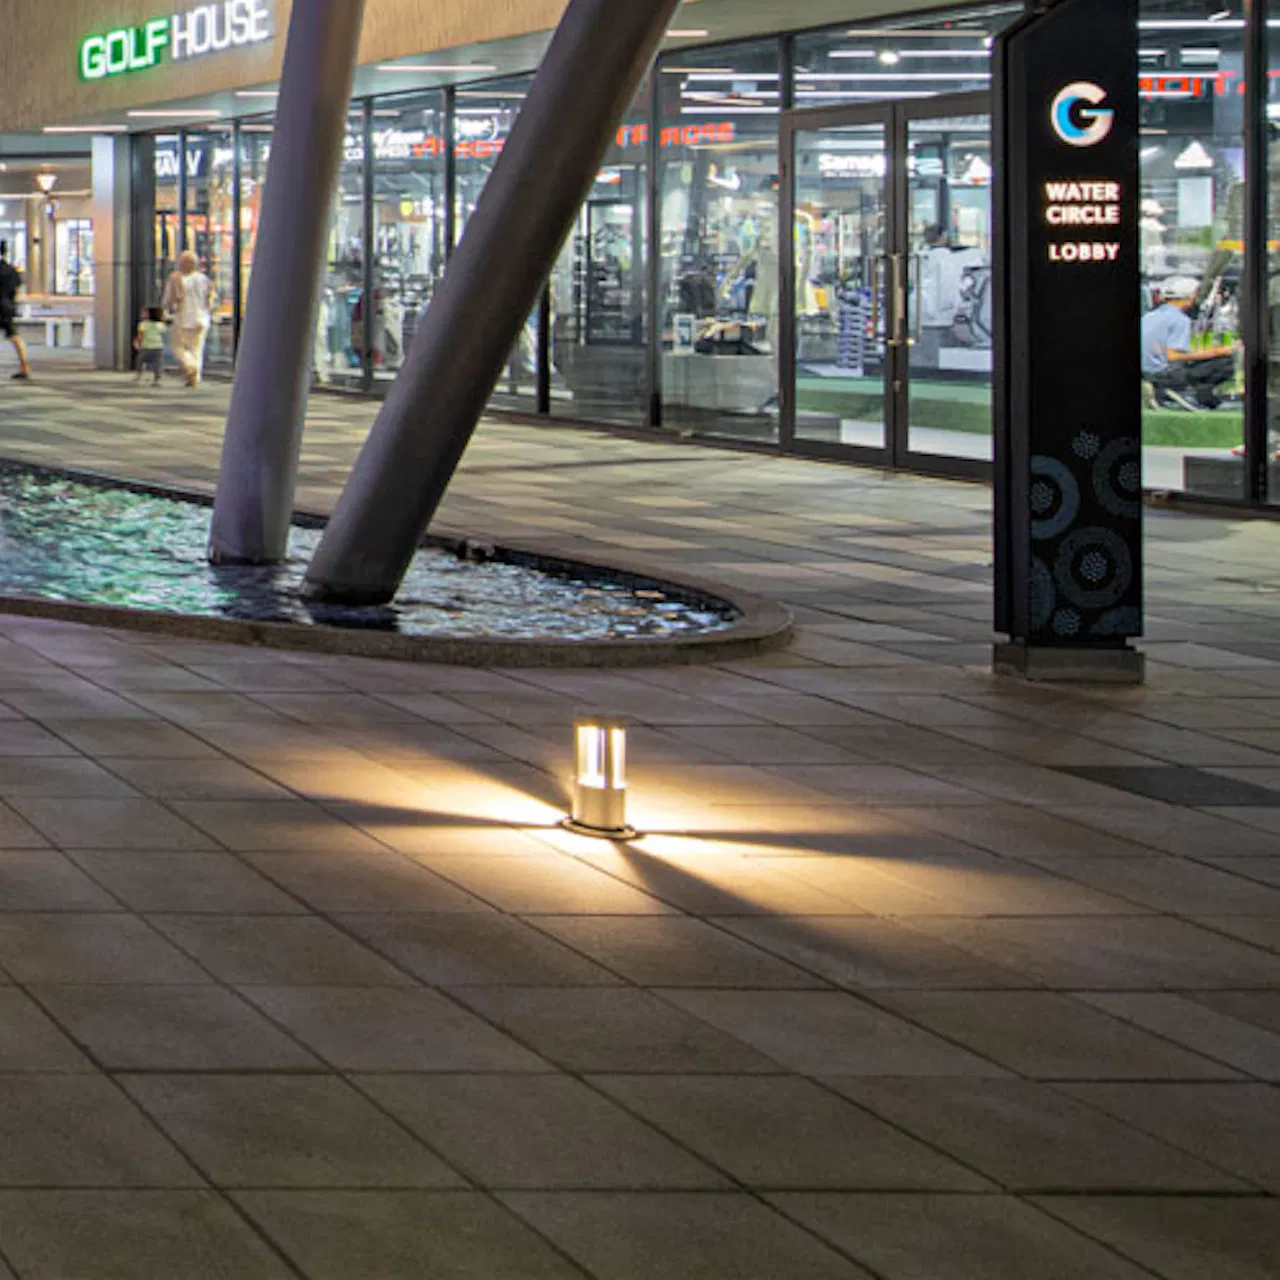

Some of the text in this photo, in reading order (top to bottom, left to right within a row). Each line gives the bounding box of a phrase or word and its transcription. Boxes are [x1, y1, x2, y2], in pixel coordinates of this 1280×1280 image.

[81, 18, 168, 79] GOLF
[1045, 183, 1120, 202] WATER
[1045, 206, 1120, 225] CIRCLE
[1048, 243, 1120, 261] LOBBY
